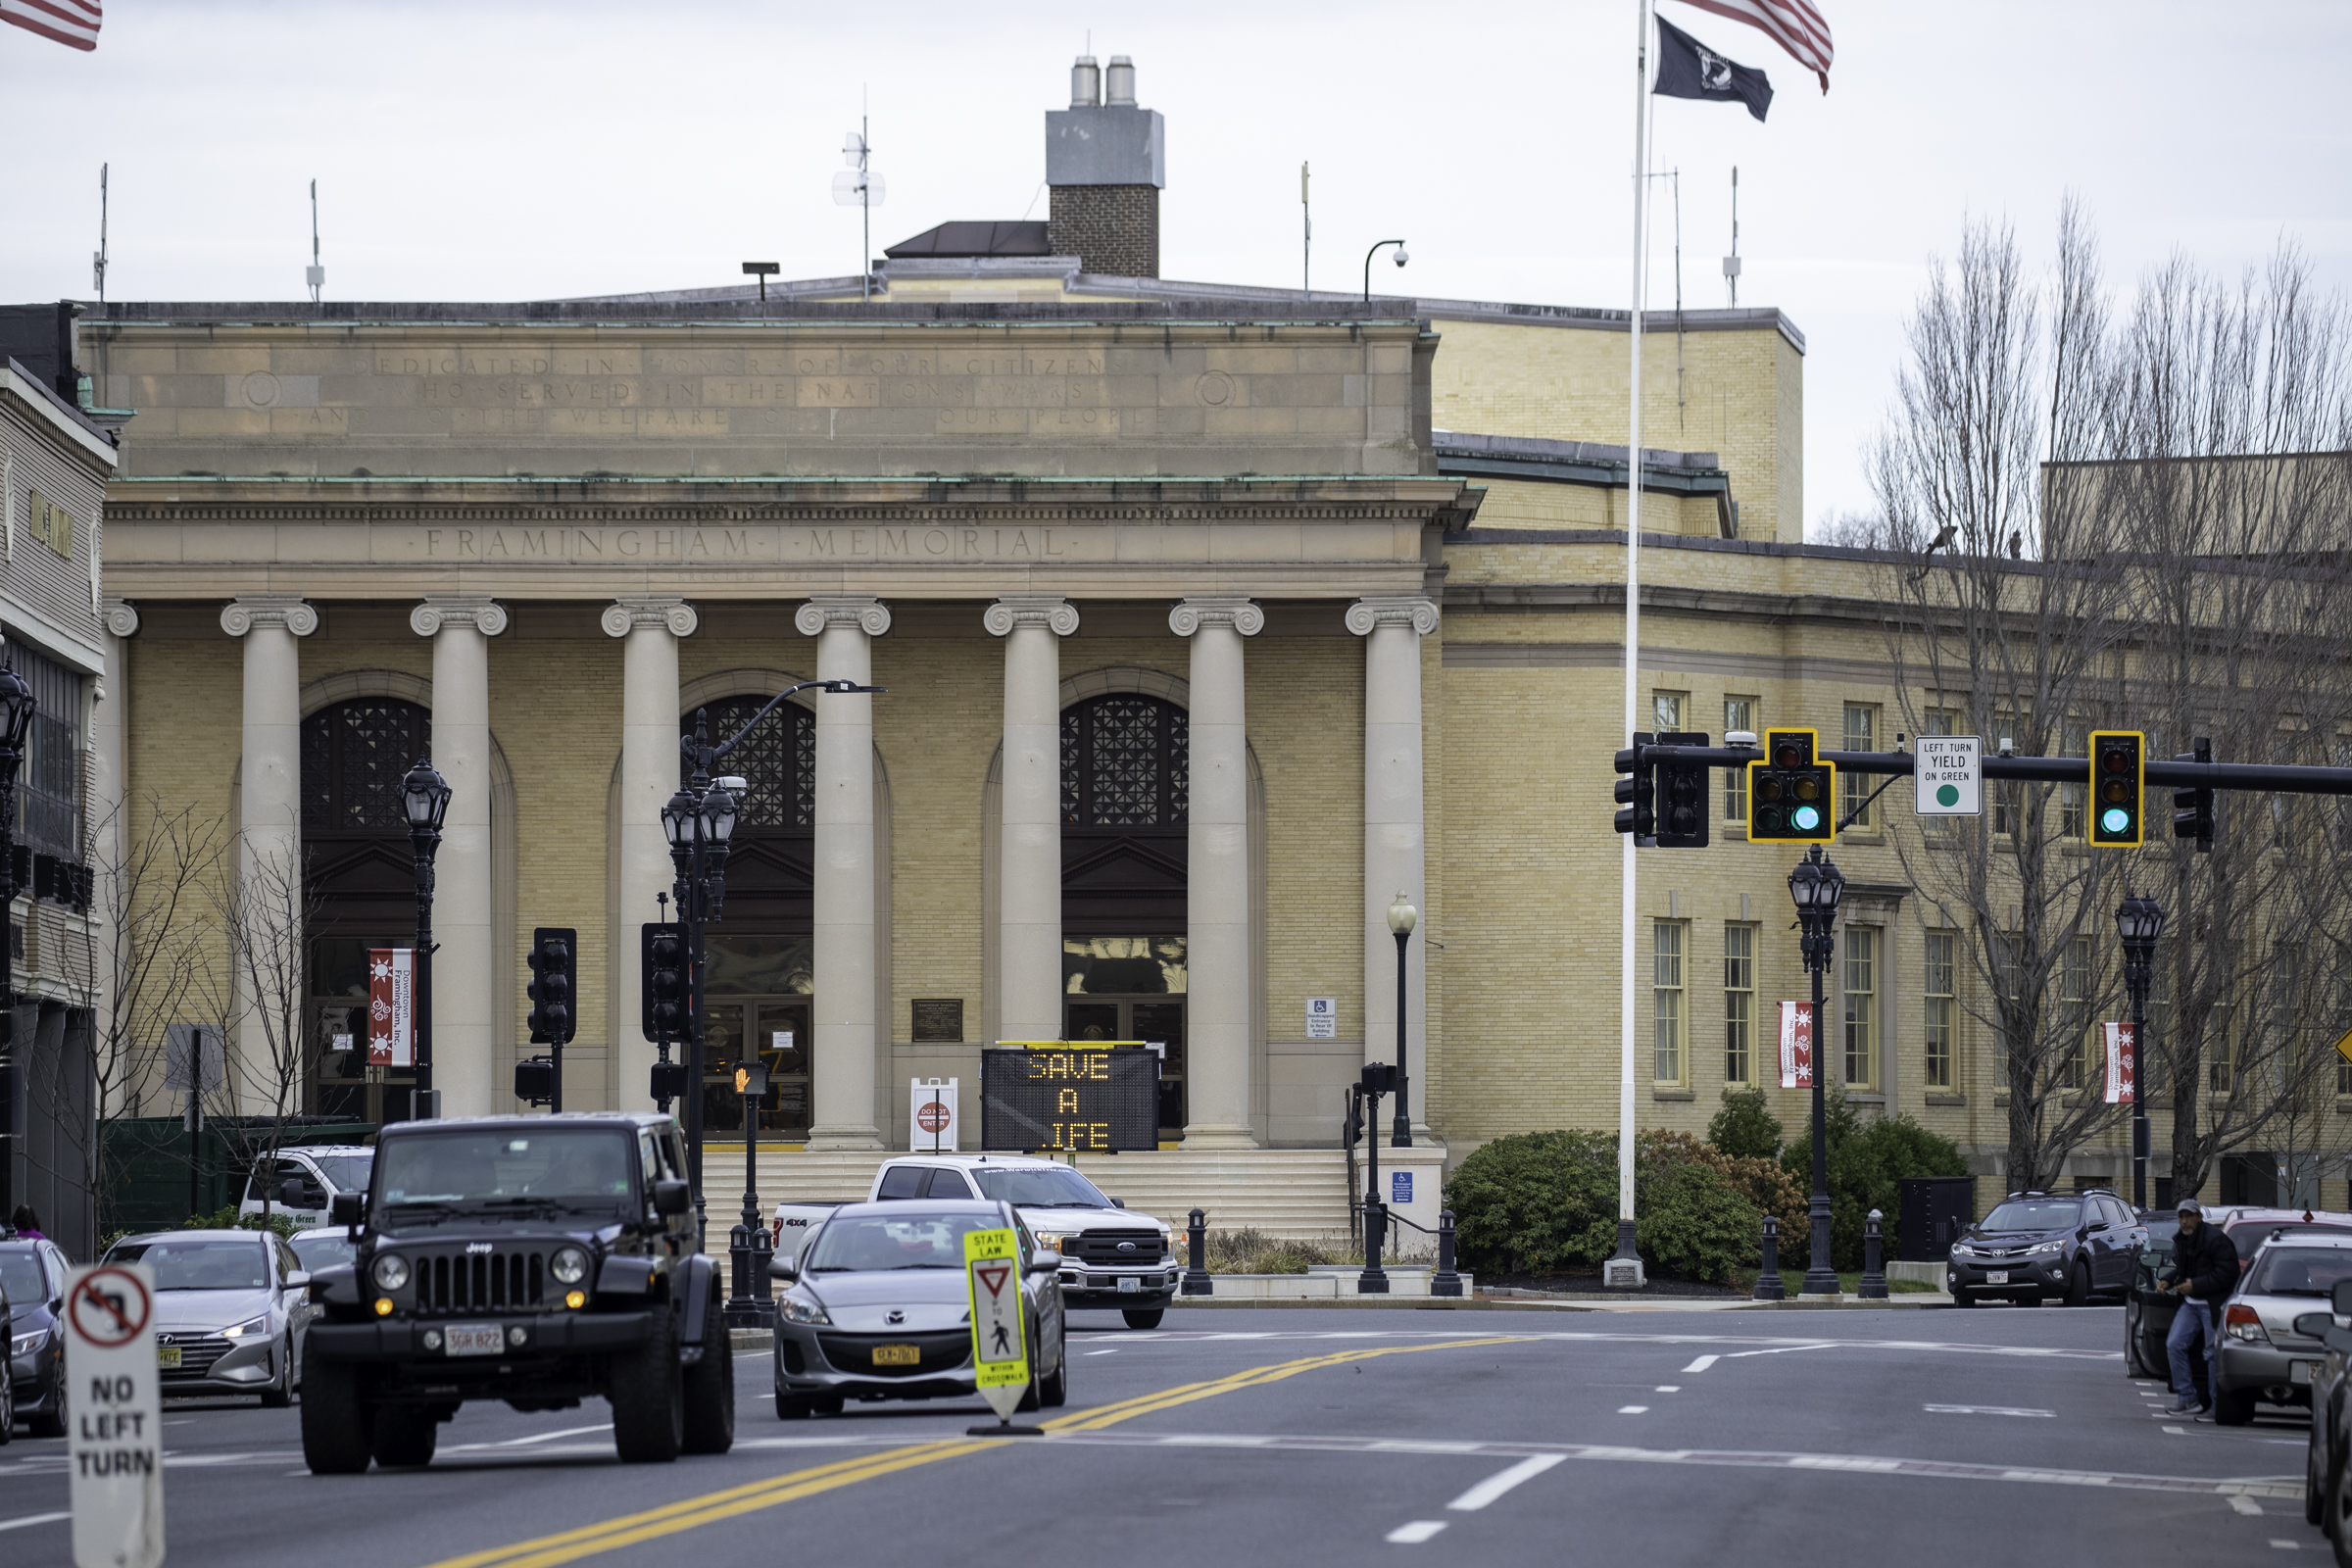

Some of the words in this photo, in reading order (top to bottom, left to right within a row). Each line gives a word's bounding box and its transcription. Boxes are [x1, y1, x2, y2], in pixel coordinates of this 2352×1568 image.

[354, 359, 549, 374] DEDICATED
[584, 359, 613, 374] IN
[652, 359, 761, 375] HONOR
[799, 359, 834, 374] OF
[870, 359, 930, 374] OUR
[498, 383, 630, 400] SERVED
[665, 383, 694, 400] IN
[725, 383, 786, 400] THE
[1001, 383, 1082, 400] WARS
[310, 409, 369, 424] AND
[478, 409, 539, 424] THE
[571, 409, 727, 425] WELFARE
[763, 409, 799, 424] OF
[939, 409, 1001, 424] OUR
[1036, 409, 1168, 425] PEOPLE
[426, 529, 752, 556] FRAMINGHAM
[808, 529, 1064, 556] MEMORIAL
[677, 572, 755, 581] ERECTED
[775, 572, 813, 581] 1926
[1924, 743, 1943, 753] LEFT
[1950, 743, 1972, 753] TURN
[1931, 756, 1966, 768] YIELD
[1925, 772, 1936, 781] ON
[1941, 772, 1970, 781] GREEN
[392, 969, 403, 1028] Framingham,
[1029, 1054, 1108, 1079] SAVE
[1058, 1088, 1077, 1113] A
[295, 1213, 317, 1224] Green
[466, 1242, 493, 1253] Jeep
[974, 1234, 1006, 1247] STATE
[980, 1246, 1003, 1257] LAW
[990, 1363, 1014, 1373] WITHIN
[981, 1372, 1025, 1385] CROSSWALK
[91, 1374, 134, 1405] NO
[80, 1411, 144, 1441] LEFT
[75, 1448, 155, 1479] TURN
